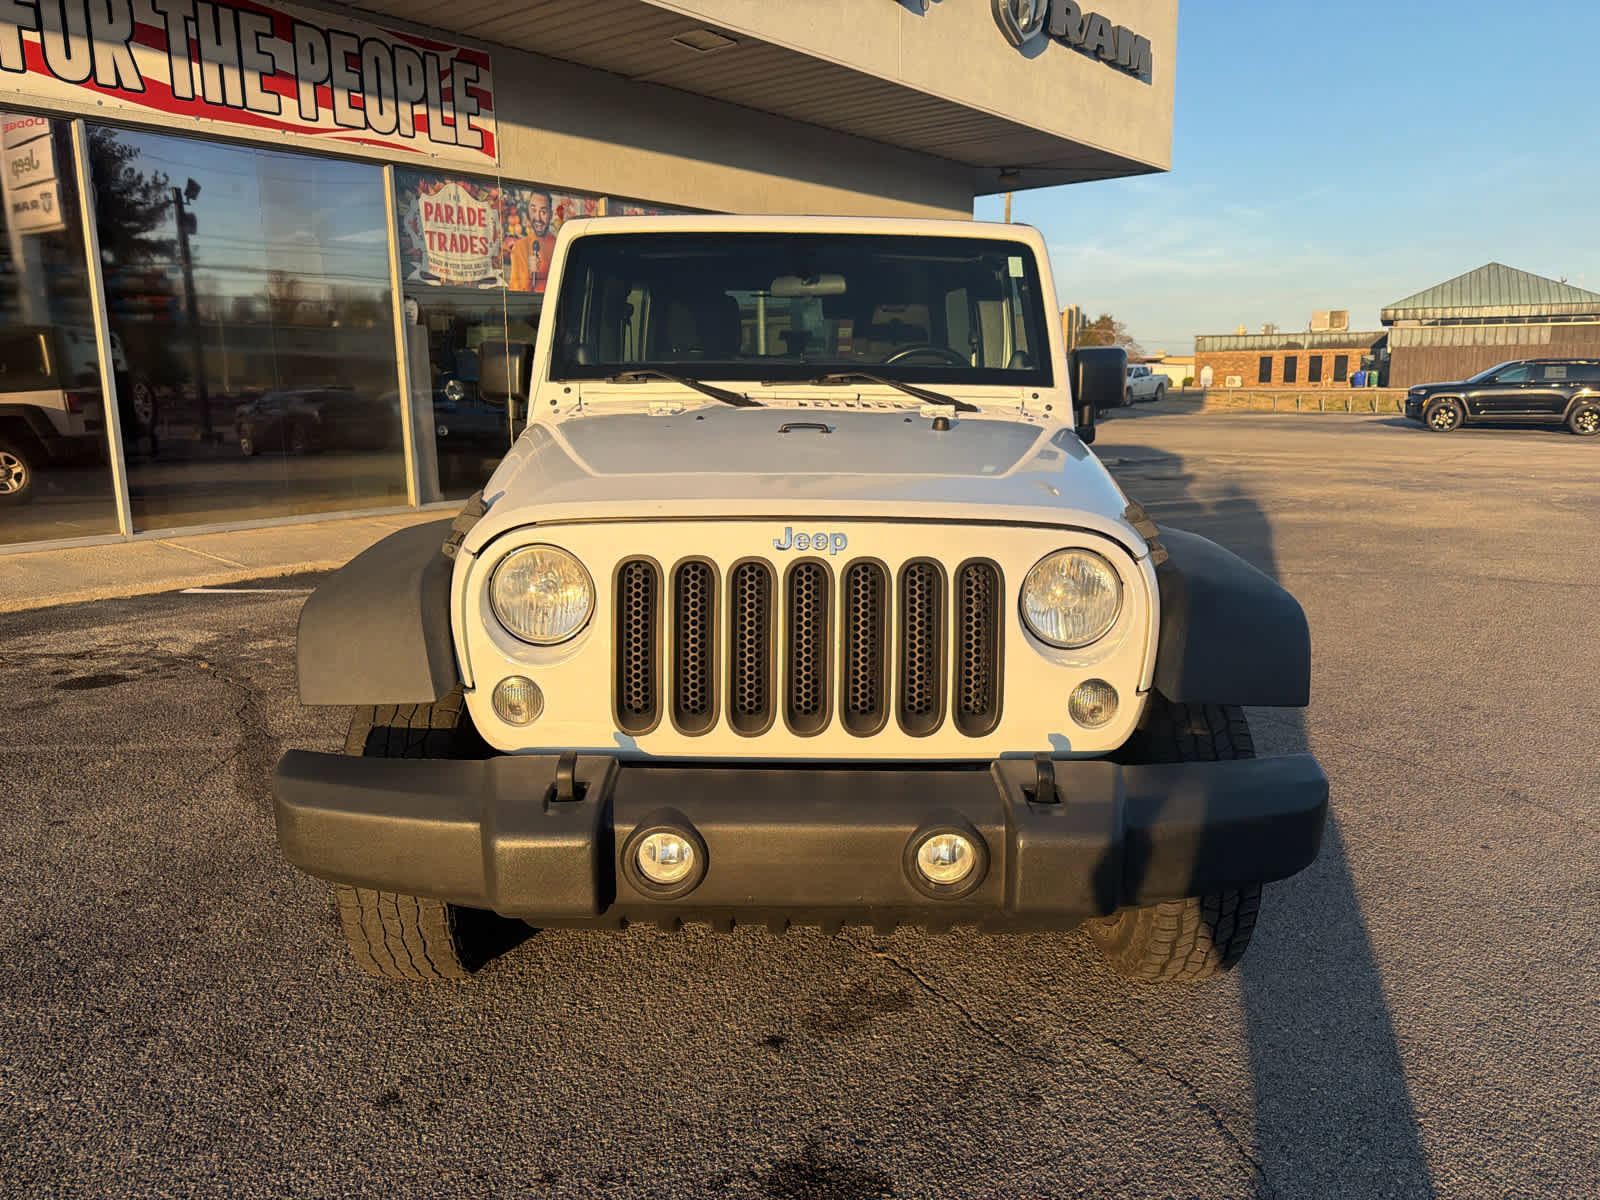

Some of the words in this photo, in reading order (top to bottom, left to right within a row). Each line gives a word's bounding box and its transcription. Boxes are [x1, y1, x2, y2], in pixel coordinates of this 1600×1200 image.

[1049, 0, 1152, 76] RAM
[151, 0, 281, 115] THE
[291, 20, 484, 149] PEOPLE
[424, 201, 488, 228] PARADE
[424, 230, 489, 256] TRADES
[773, 526, 848, 556] Jeep
